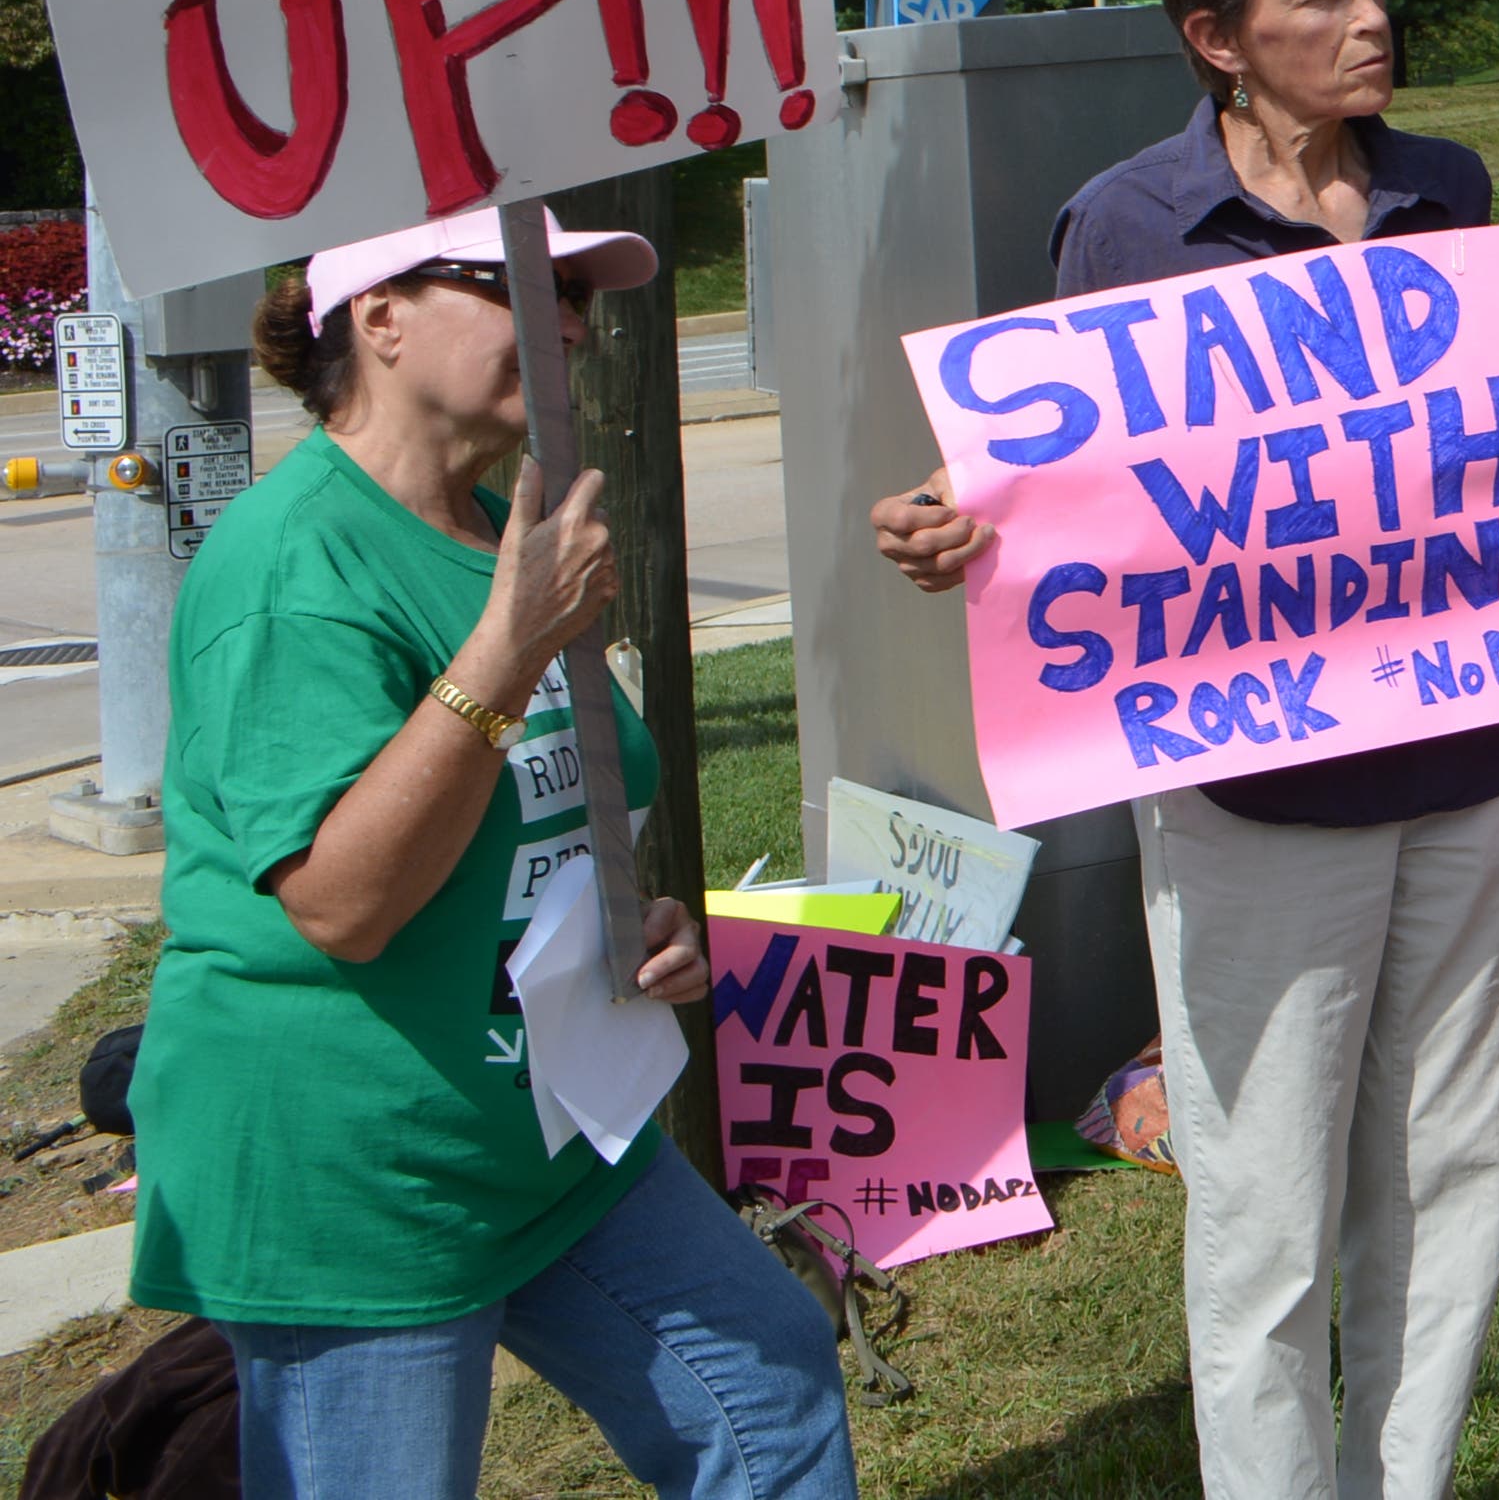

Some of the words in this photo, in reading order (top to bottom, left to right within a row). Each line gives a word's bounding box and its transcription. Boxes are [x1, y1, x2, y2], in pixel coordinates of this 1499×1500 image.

[939, 245, 1460, 467] STAND
[1114, 651, 1341, 769] ROCK
[523, 744, 580, 799] RID
[712, 932, 1009, 1060] WATER
[729, 1051, 896, 1158] IS
